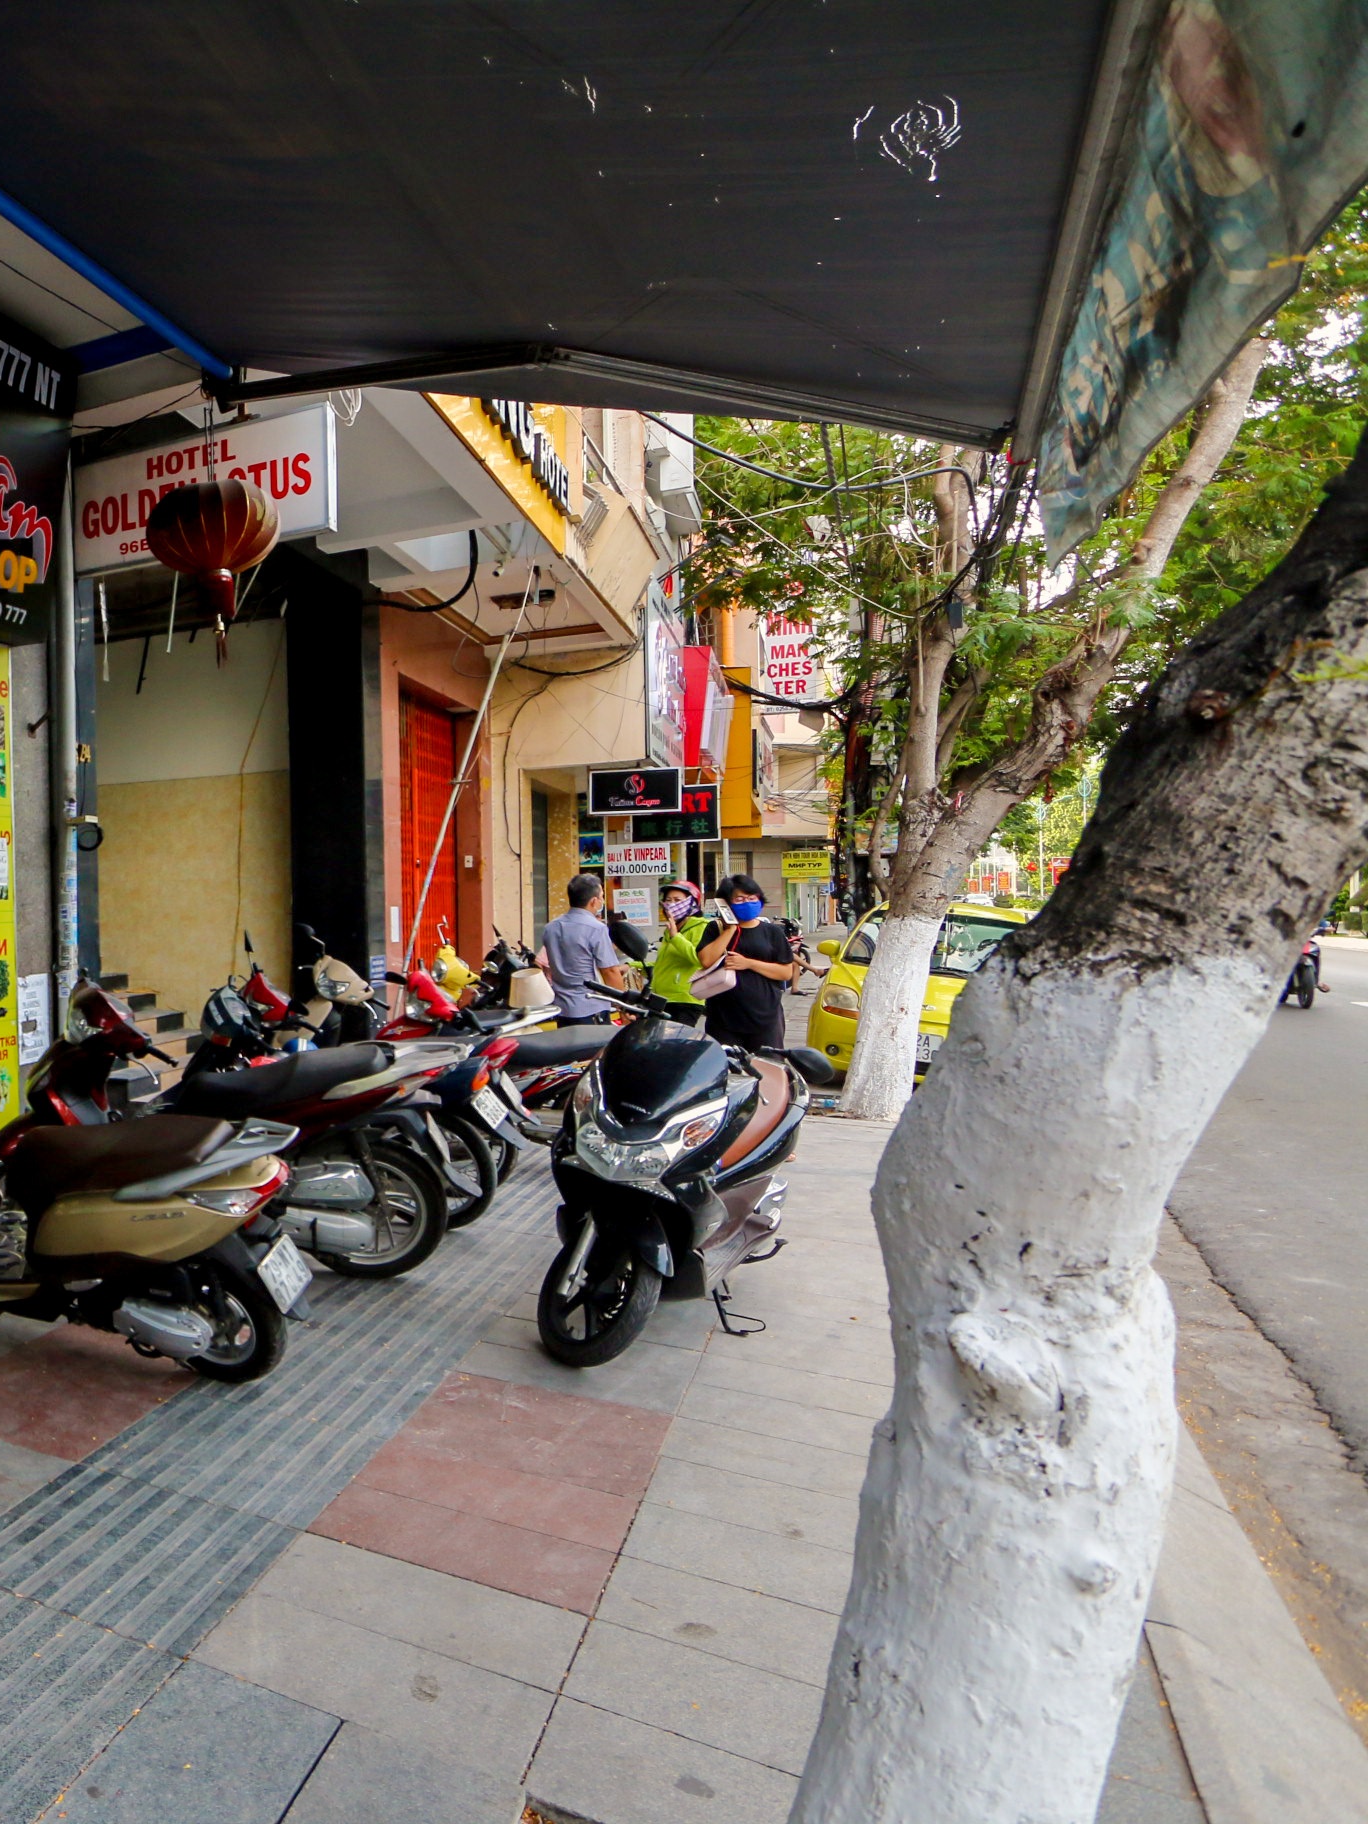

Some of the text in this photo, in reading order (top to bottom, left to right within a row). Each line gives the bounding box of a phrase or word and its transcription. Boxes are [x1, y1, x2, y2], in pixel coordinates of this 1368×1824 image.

[34, 362, 61, 410] NT
[146, 438, 237, 480] HOTEL
[6, 605, 27, 626] 777
[770, 643, 809, 660] MAN
[767, 660, 812, 679] CHES
[773, 680, 807, 695] TER
[634, 847, 667, 861] VINPEARL
